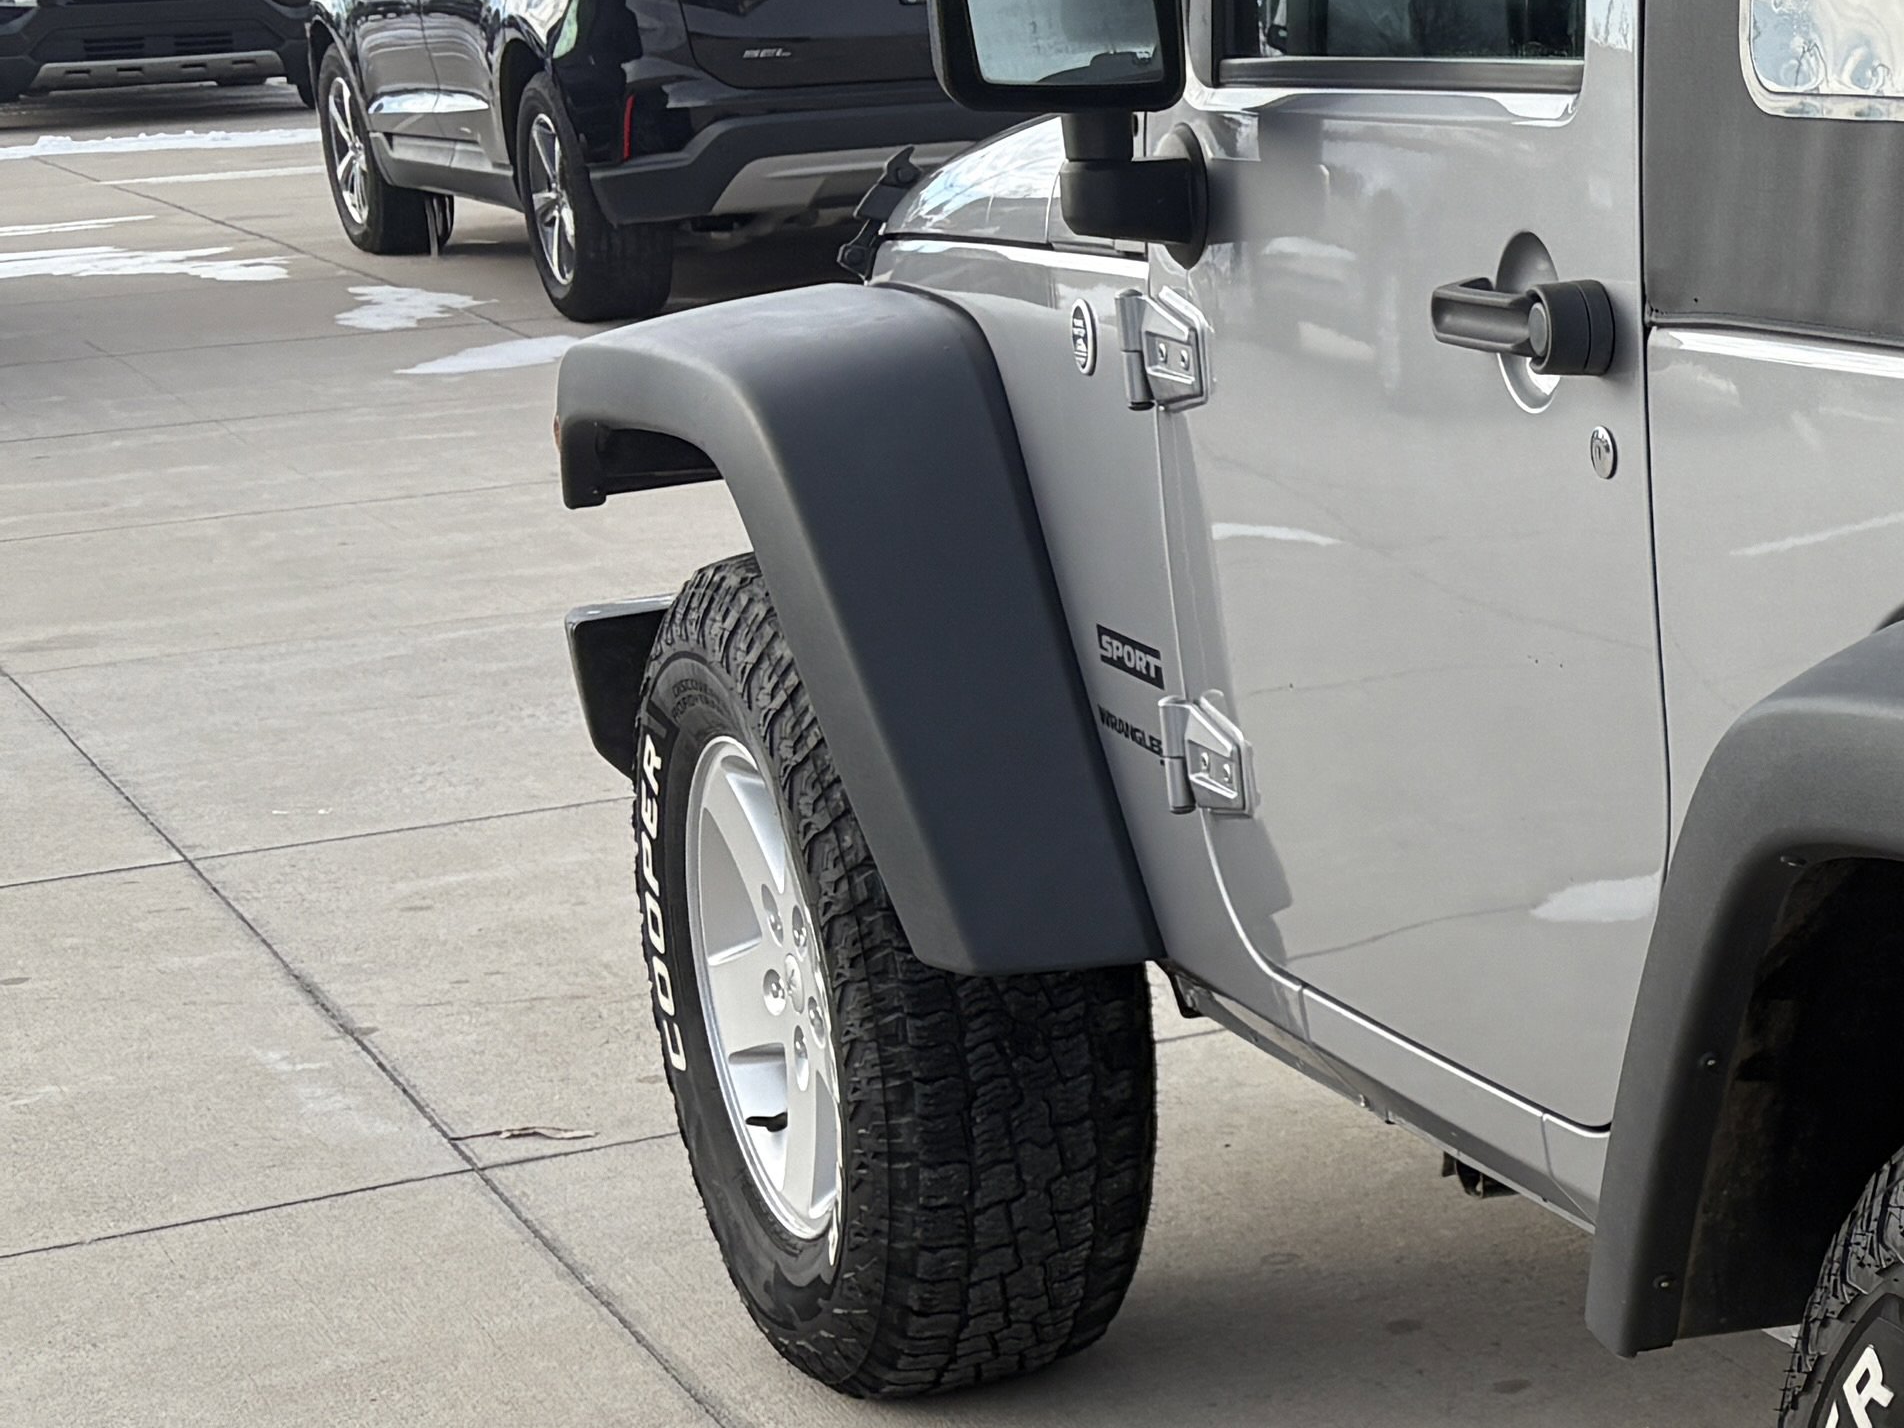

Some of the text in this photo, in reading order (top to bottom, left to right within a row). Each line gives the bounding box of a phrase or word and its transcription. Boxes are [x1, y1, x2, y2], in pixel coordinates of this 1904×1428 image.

[1099, 634, 1163, 679] SPORT
[1097, 704, 1163, 758] WRANGLE
[638, 732, 687, 1072] COOPER
